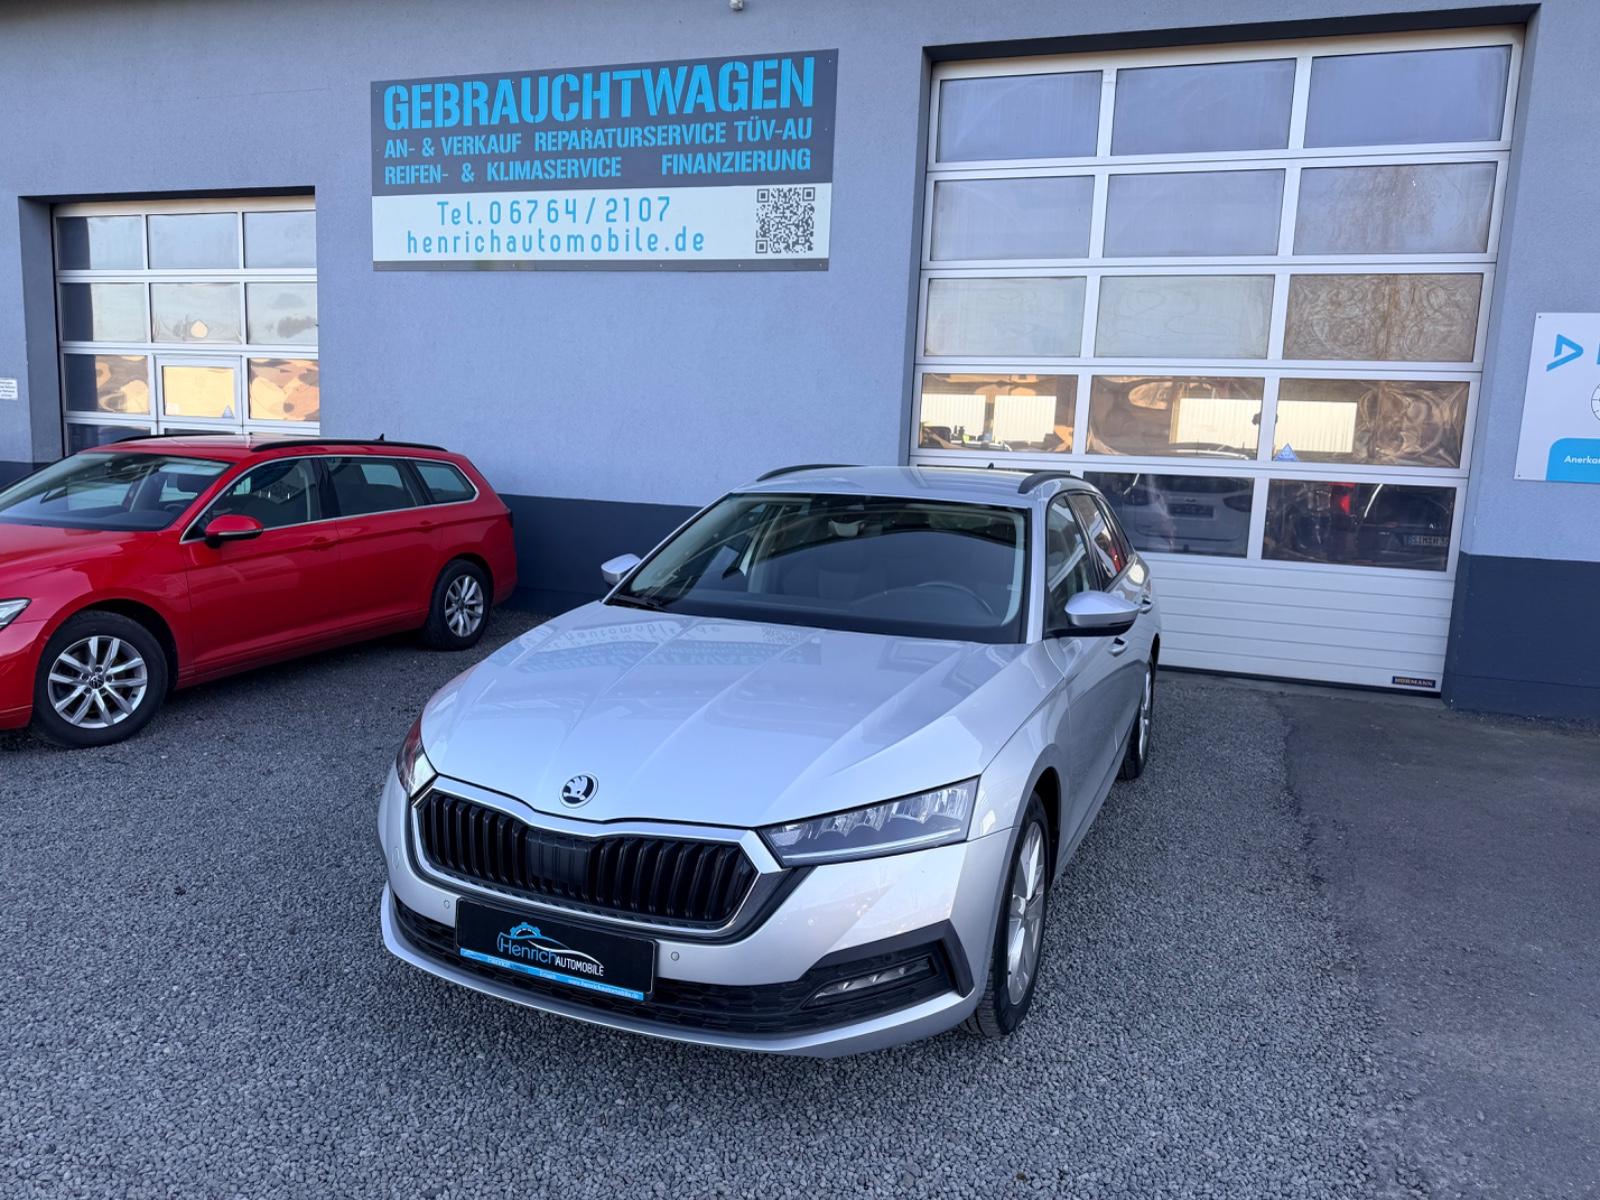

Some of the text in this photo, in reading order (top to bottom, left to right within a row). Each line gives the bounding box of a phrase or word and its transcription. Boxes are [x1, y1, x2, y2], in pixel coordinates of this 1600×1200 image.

[383, 56, 816, 132] GEBRAUCHTWAGEN
[384, 115, 813, 159] AN- & VERKAUF REPARATURSERVICE TÜV-AU
[384, 146, 811, 186] REIFEN- & KLIMASERVICE FINANZIERUNG
[406, 225, 705, 254] henrichautomobile.de
[1563, 455, 1600, 466] Anerka
[499, 934, 557, 964] Henrich
[554, 955, 605, 977] AUTOMOBILE
